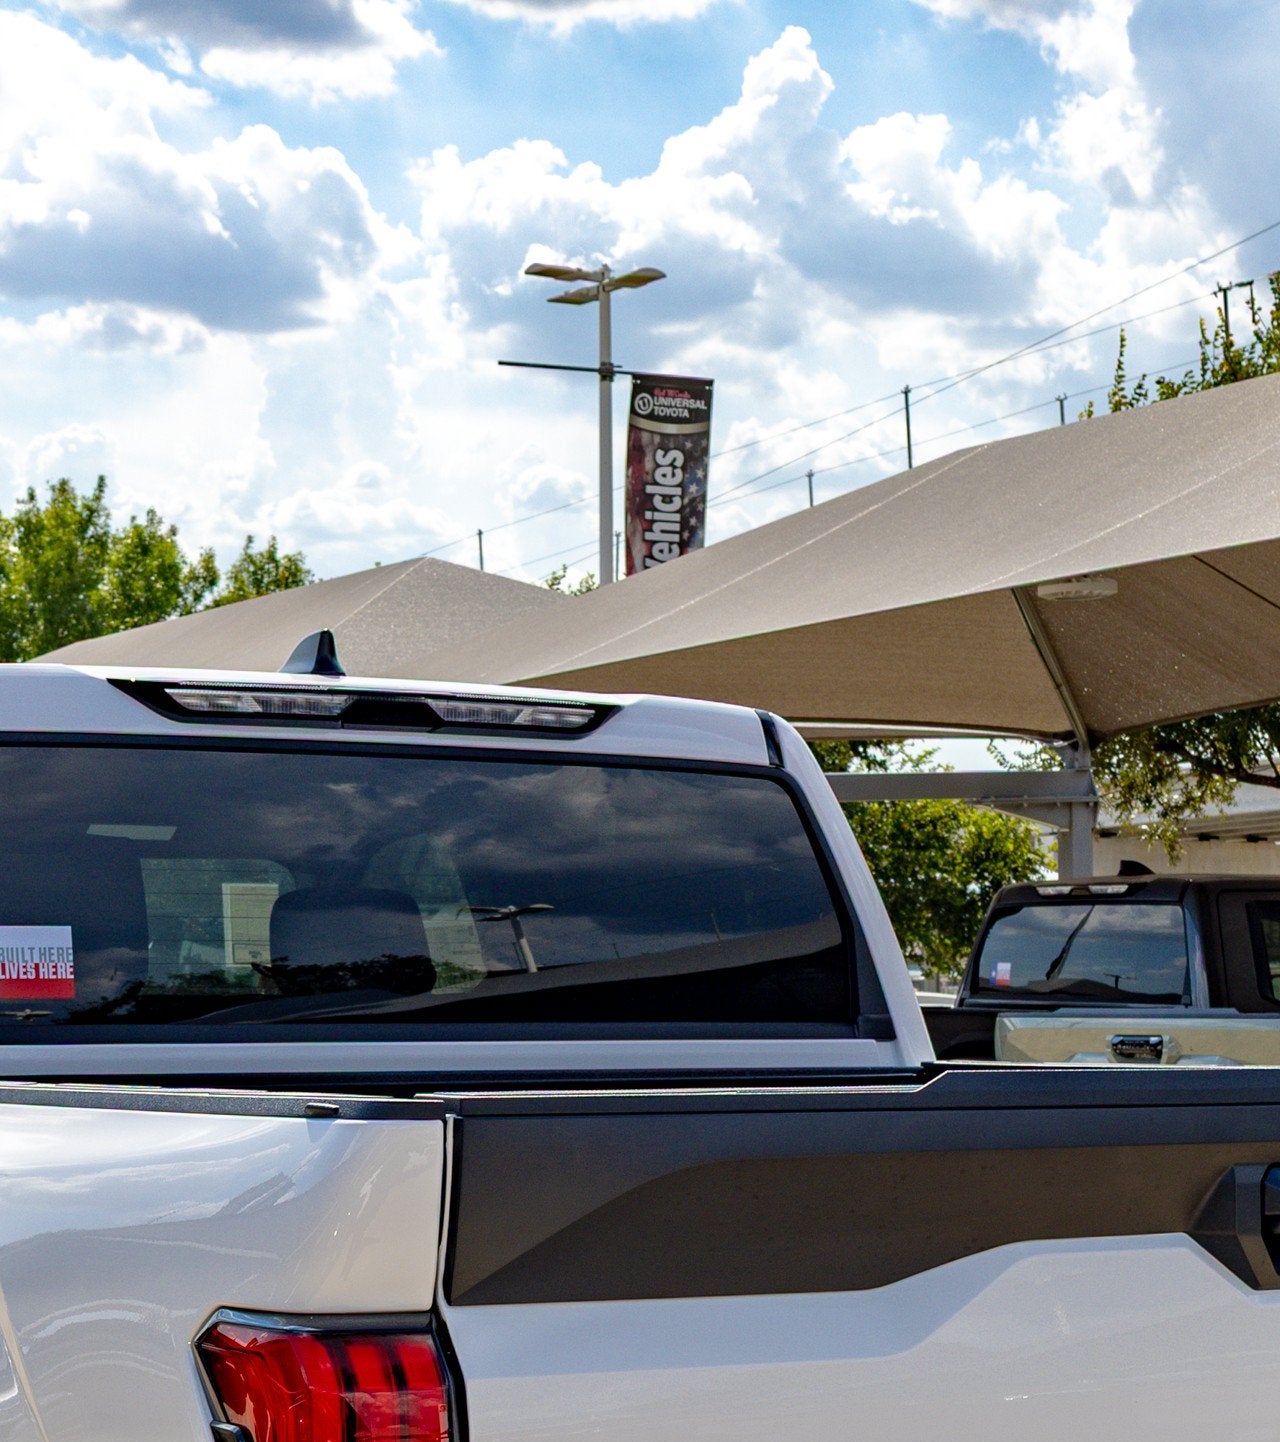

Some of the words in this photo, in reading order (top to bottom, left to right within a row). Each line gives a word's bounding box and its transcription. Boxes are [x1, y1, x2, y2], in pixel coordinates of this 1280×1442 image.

[653, 396, 707, 410] UNIVERSAL
[653, 406, 690, 418] TOYOTA
[38, 946, 74, 963] HERE
[39, 962, 75, 980] HERE
